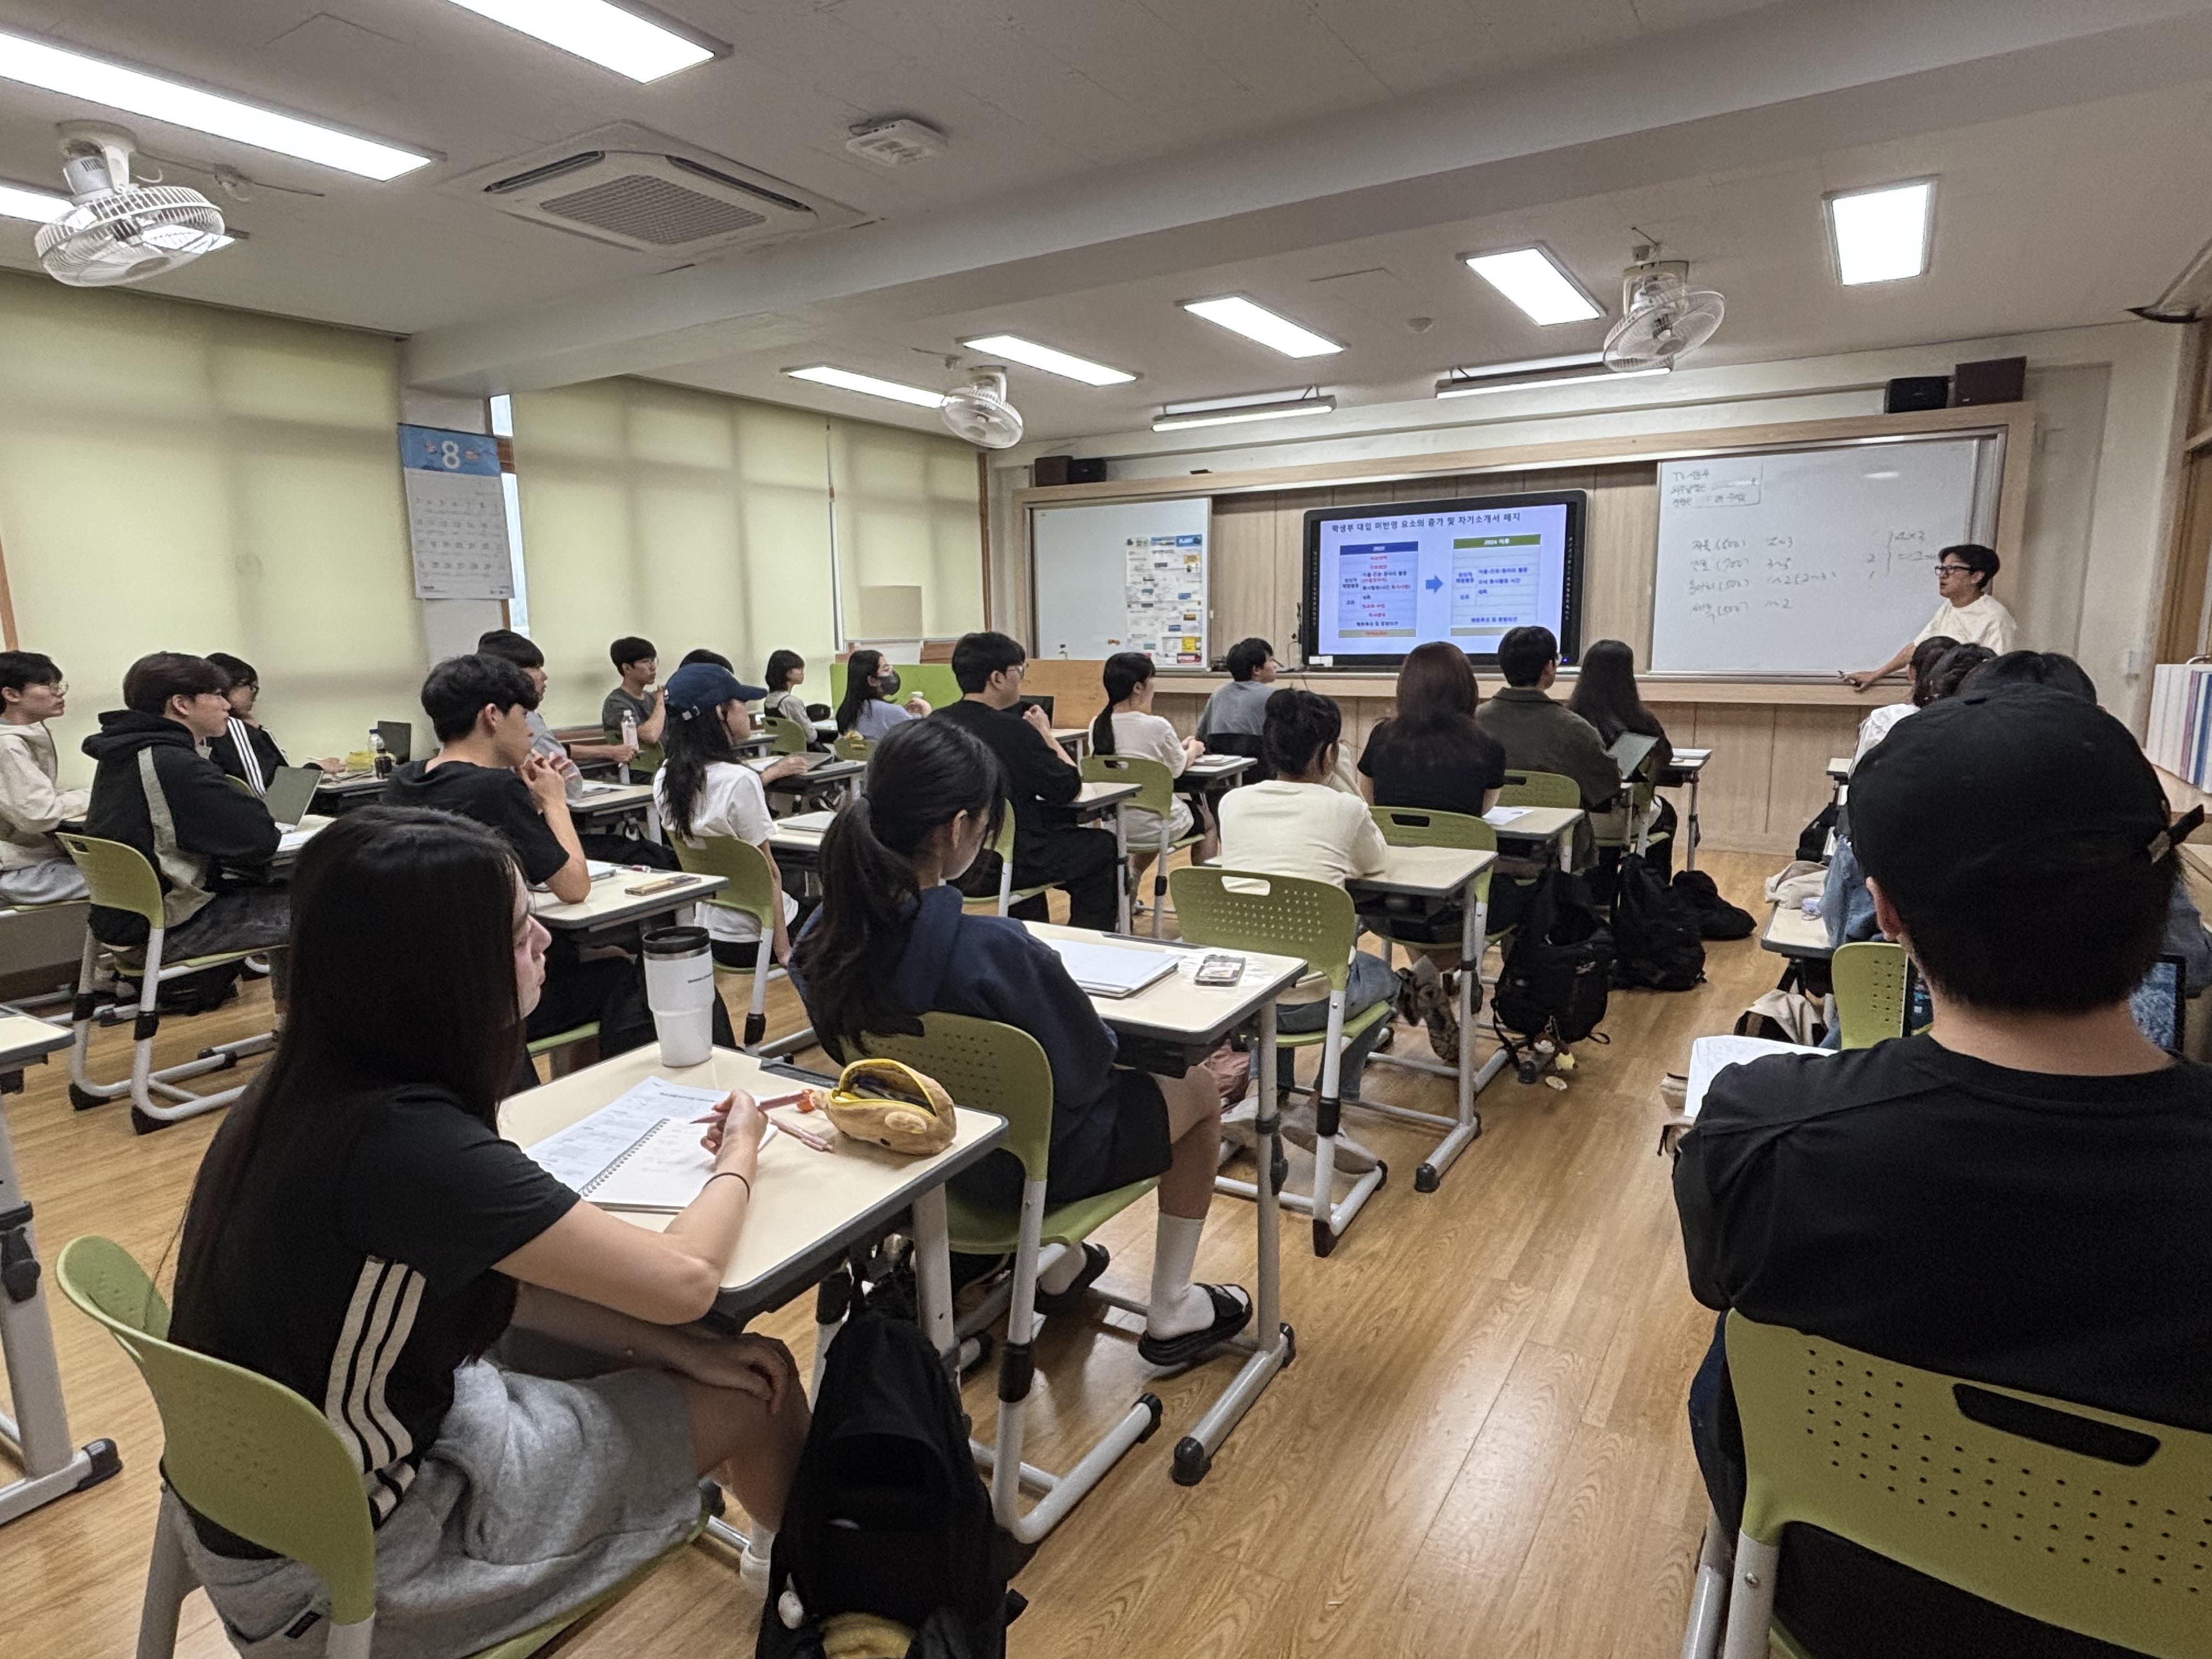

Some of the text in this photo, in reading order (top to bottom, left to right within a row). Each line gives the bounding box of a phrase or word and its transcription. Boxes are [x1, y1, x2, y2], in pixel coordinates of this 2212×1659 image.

[442, 440, 461, 470] 8
[1357, 522, 1372, 531] 대입
[1401, 518, 1424, 528] 요소의
[1458, 514, 1500, 524] 자기소개서
